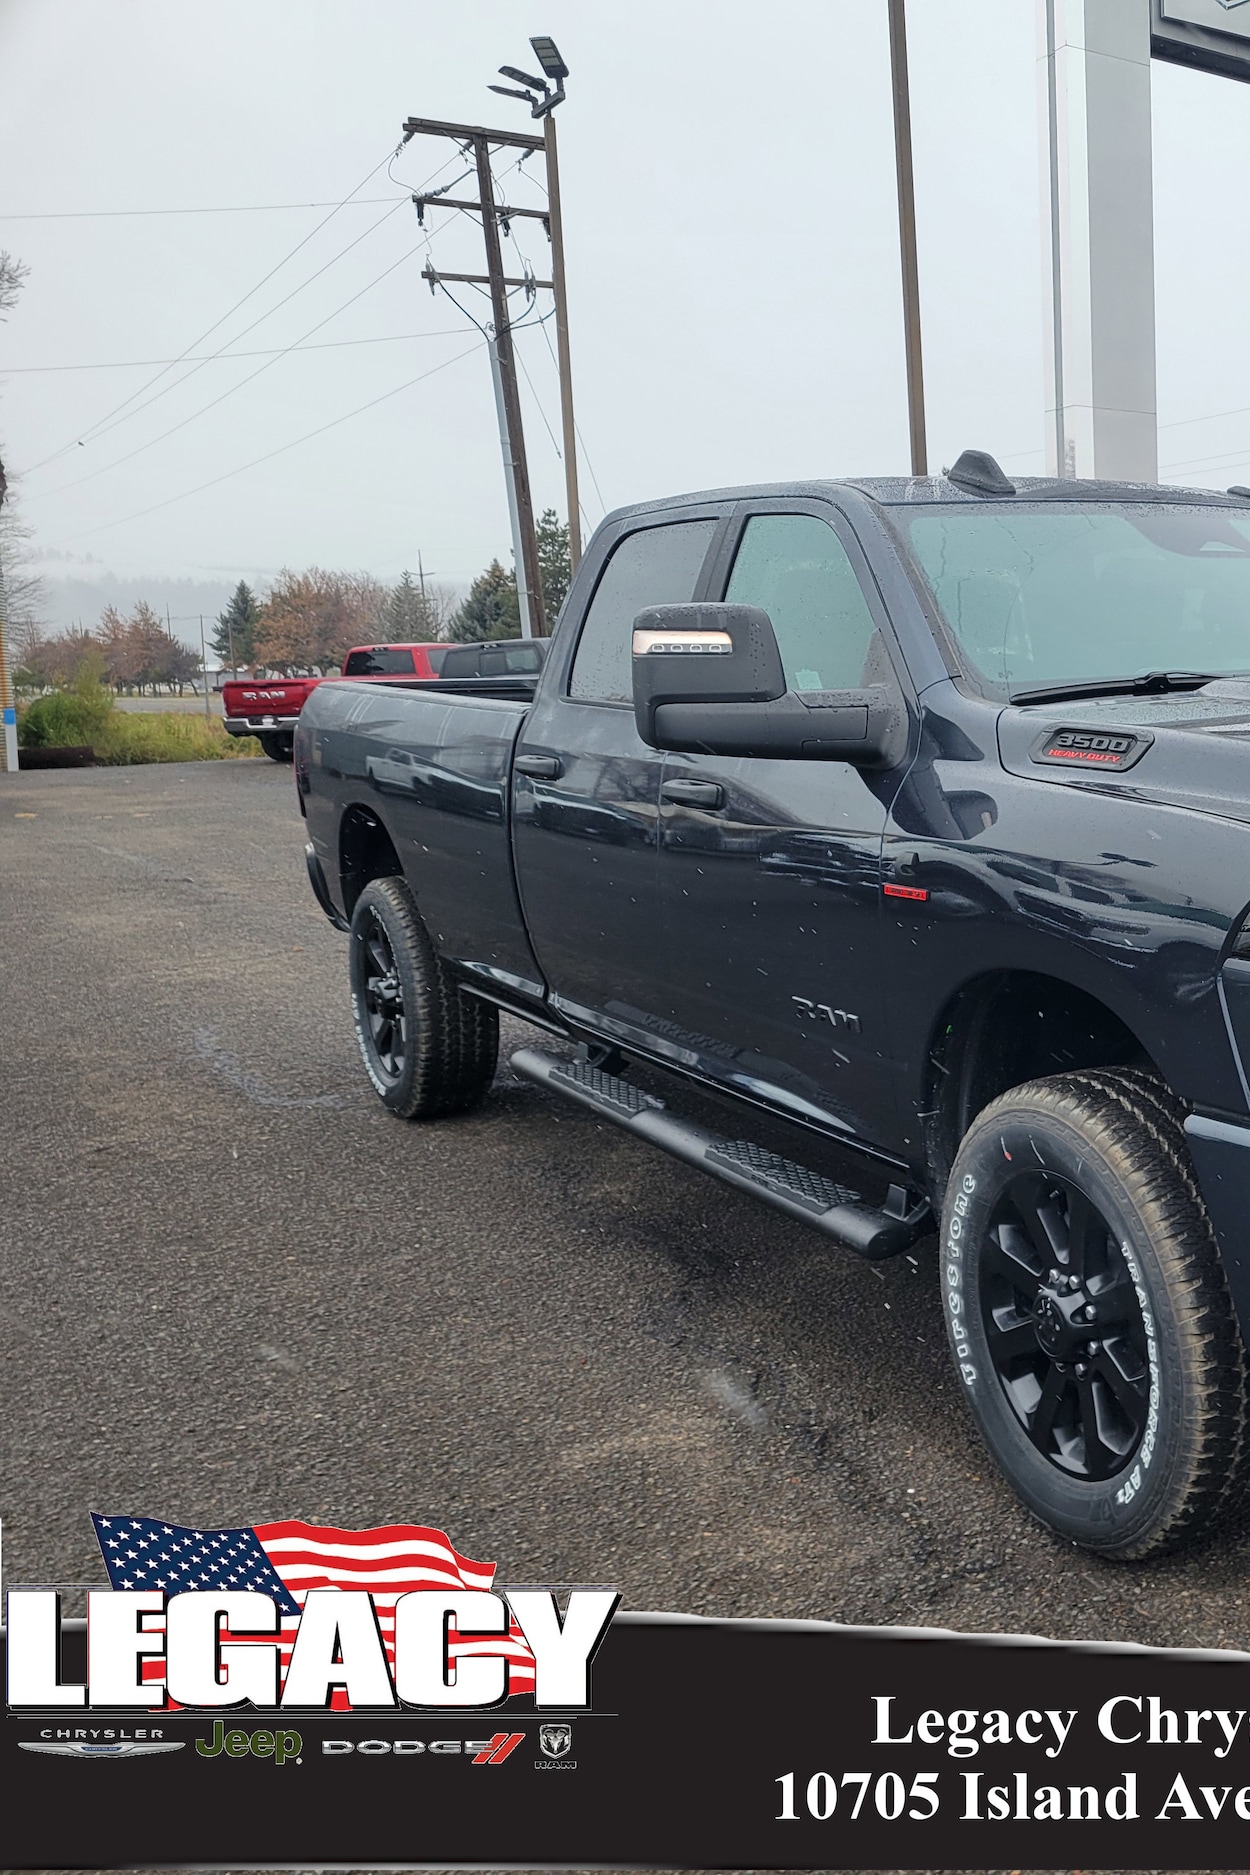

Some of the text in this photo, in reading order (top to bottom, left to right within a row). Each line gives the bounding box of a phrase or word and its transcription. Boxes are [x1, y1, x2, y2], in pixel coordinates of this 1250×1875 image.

[242, 691, 285, 700] RAM
[1056, 734, 1129, 753] 3500
[1048, 749, 1120, 762] HEAVY DUTY
[792, 996, 862, 1033] RAM
